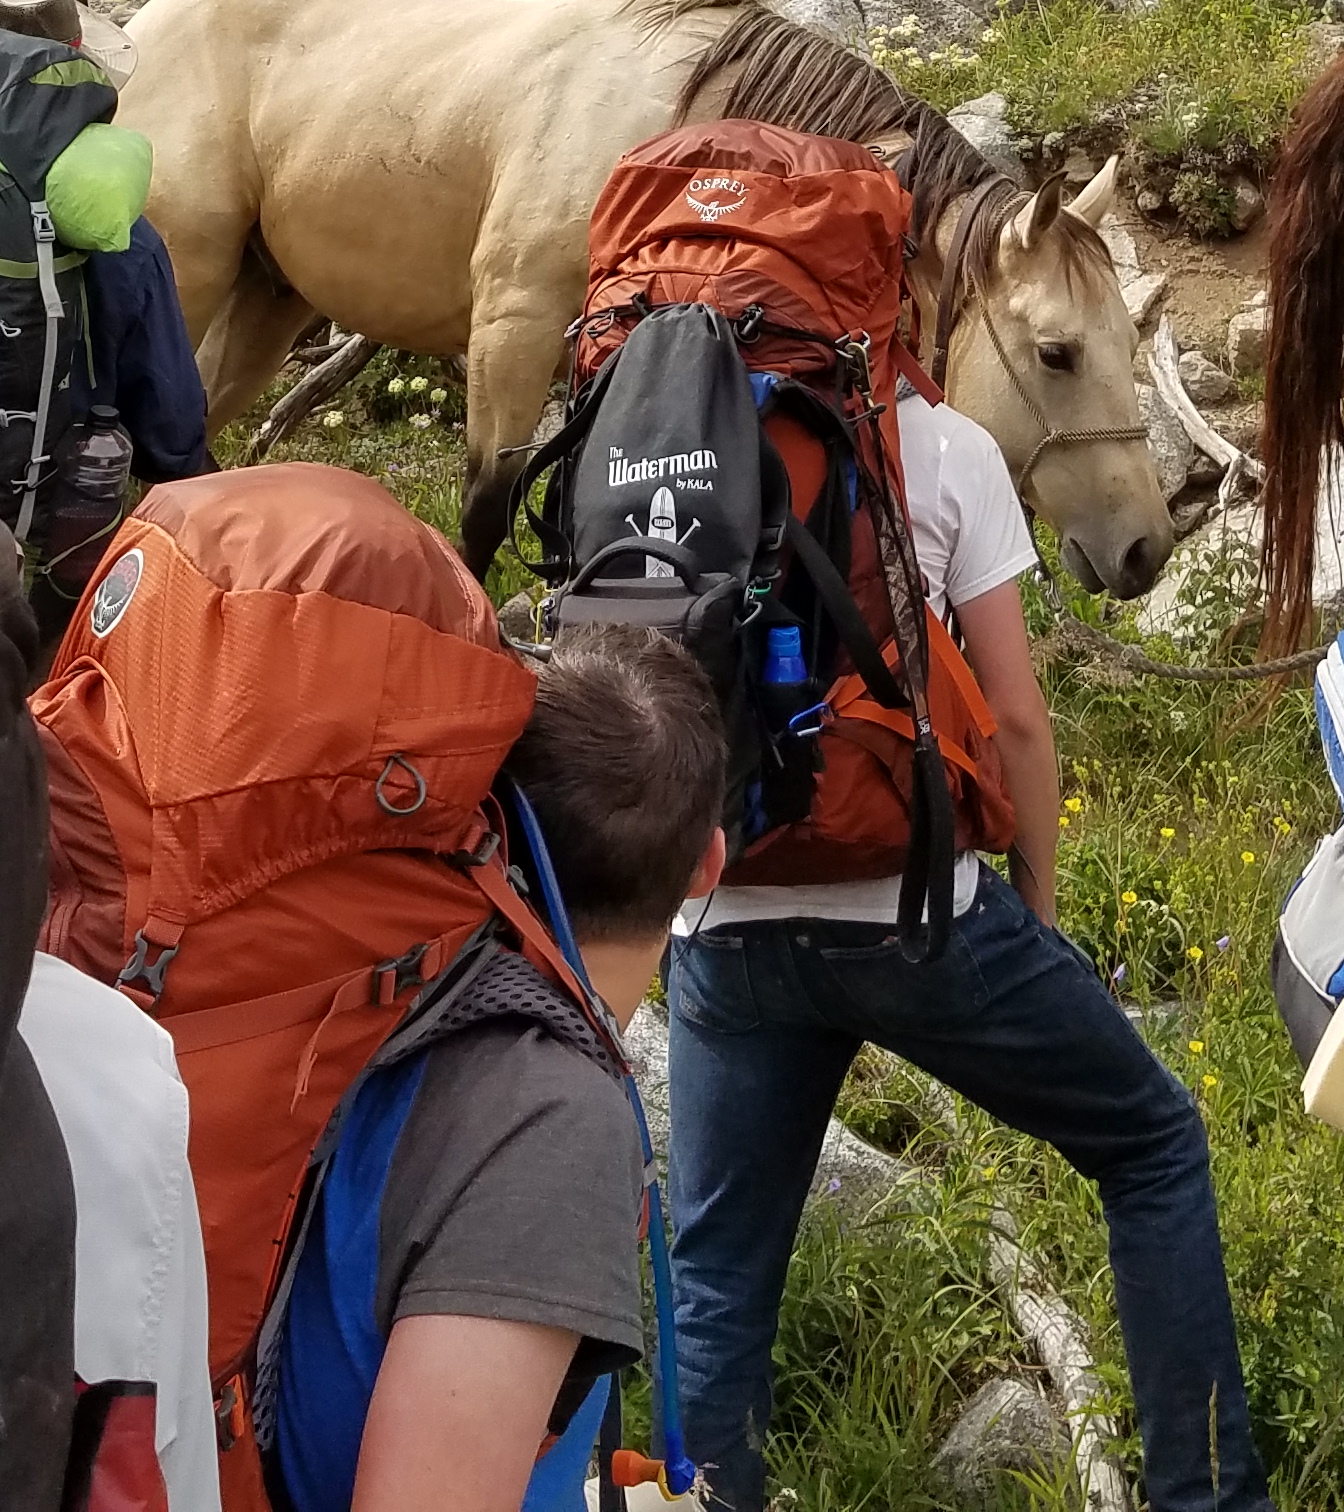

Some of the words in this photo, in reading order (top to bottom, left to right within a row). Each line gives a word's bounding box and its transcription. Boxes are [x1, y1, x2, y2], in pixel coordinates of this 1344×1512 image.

[689, 177, 750, 197] OSPREY
[609, 446, 624, 459] The
[608, 449, 718, 487] Waterman
[676, 477, 687, 490] by
[686, 478, 713, 490] KALA
